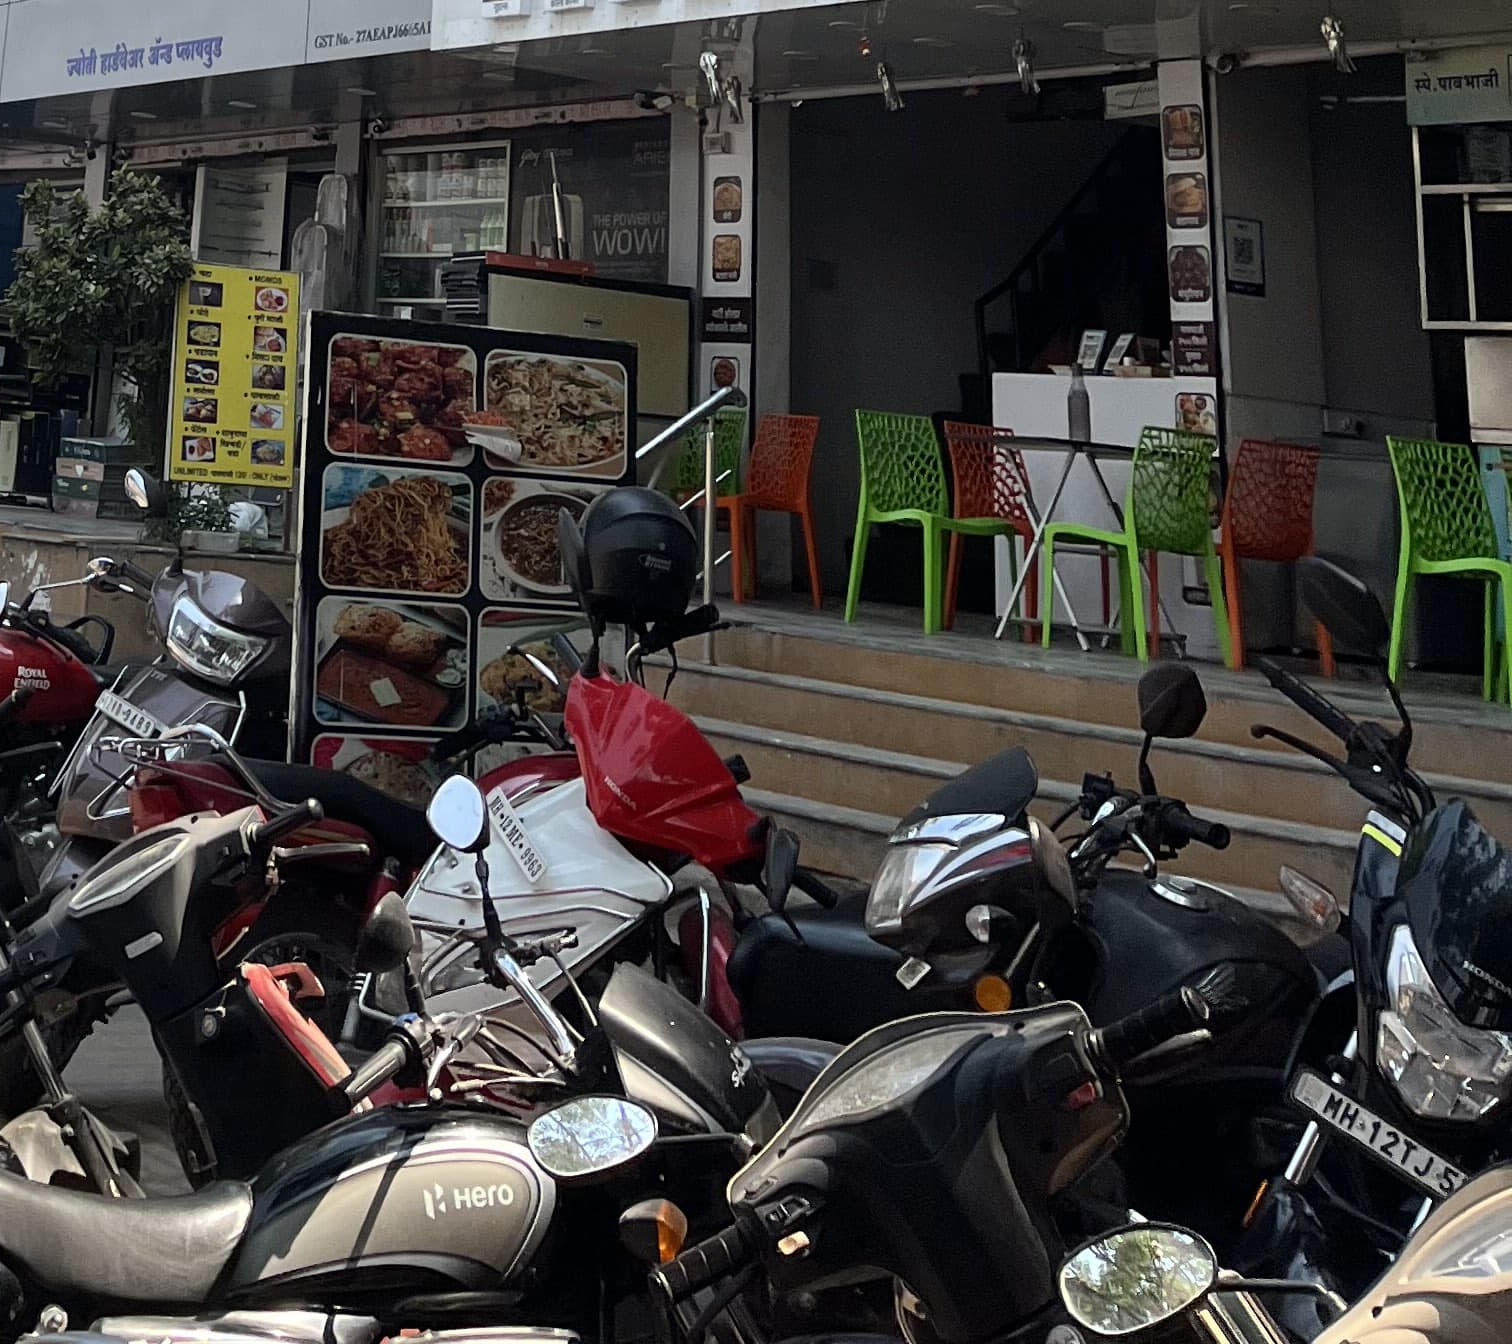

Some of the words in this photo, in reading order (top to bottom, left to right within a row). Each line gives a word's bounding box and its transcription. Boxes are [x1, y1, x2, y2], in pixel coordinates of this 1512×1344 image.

[314, 33, 334, 49] GST
[66, 48, 97, 78] ज्योती
[99, 43, 145, 76] हार्डवेअर
[175, 34, 224, 70] प्लायवुड
[592, 214, 611, 226] THE
[613, 213, 650, 226] POWER
[592, 228, 666, 257] WOW!
[17, 665, 47, 679] ROYAL
[14, 678, 50, 691] ENFIELD
[604, 775, 637, 811] HONDA
